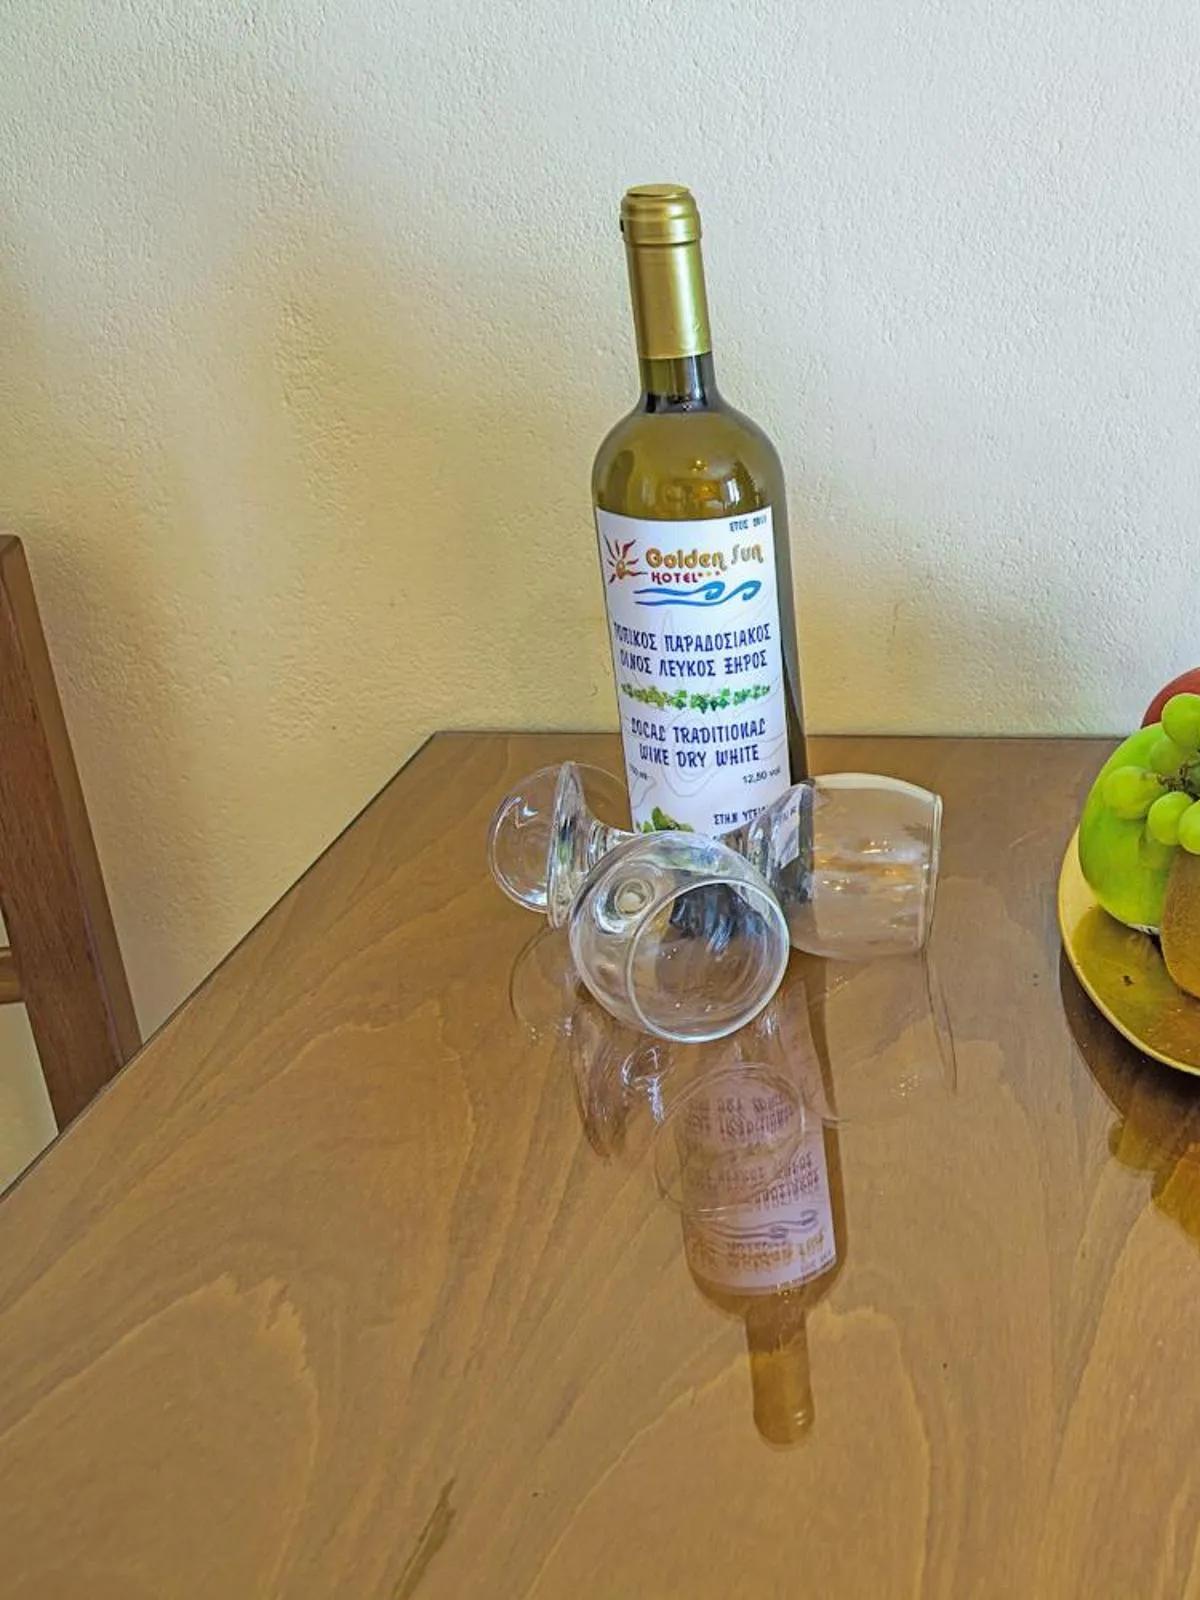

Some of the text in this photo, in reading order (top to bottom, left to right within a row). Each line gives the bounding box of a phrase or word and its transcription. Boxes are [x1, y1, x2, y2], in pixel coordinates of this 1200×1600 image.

[645, 543, 764, 571] Golden Sun
[651, 570, 698, 584] HOTEL
[664, 623, 772, 653] ΠΑΡΑΔΟΣΙΑΚΟΣ
[659, 659, 716, 678] ΛΕΥΚΟΣ
[724, 649, 768, 675] ΞΗΡΟΣ
[631, 717, 766, 744] LOCAL TRADITIONAL
[639, 743, 759, 768] WINE DRY WHITE
